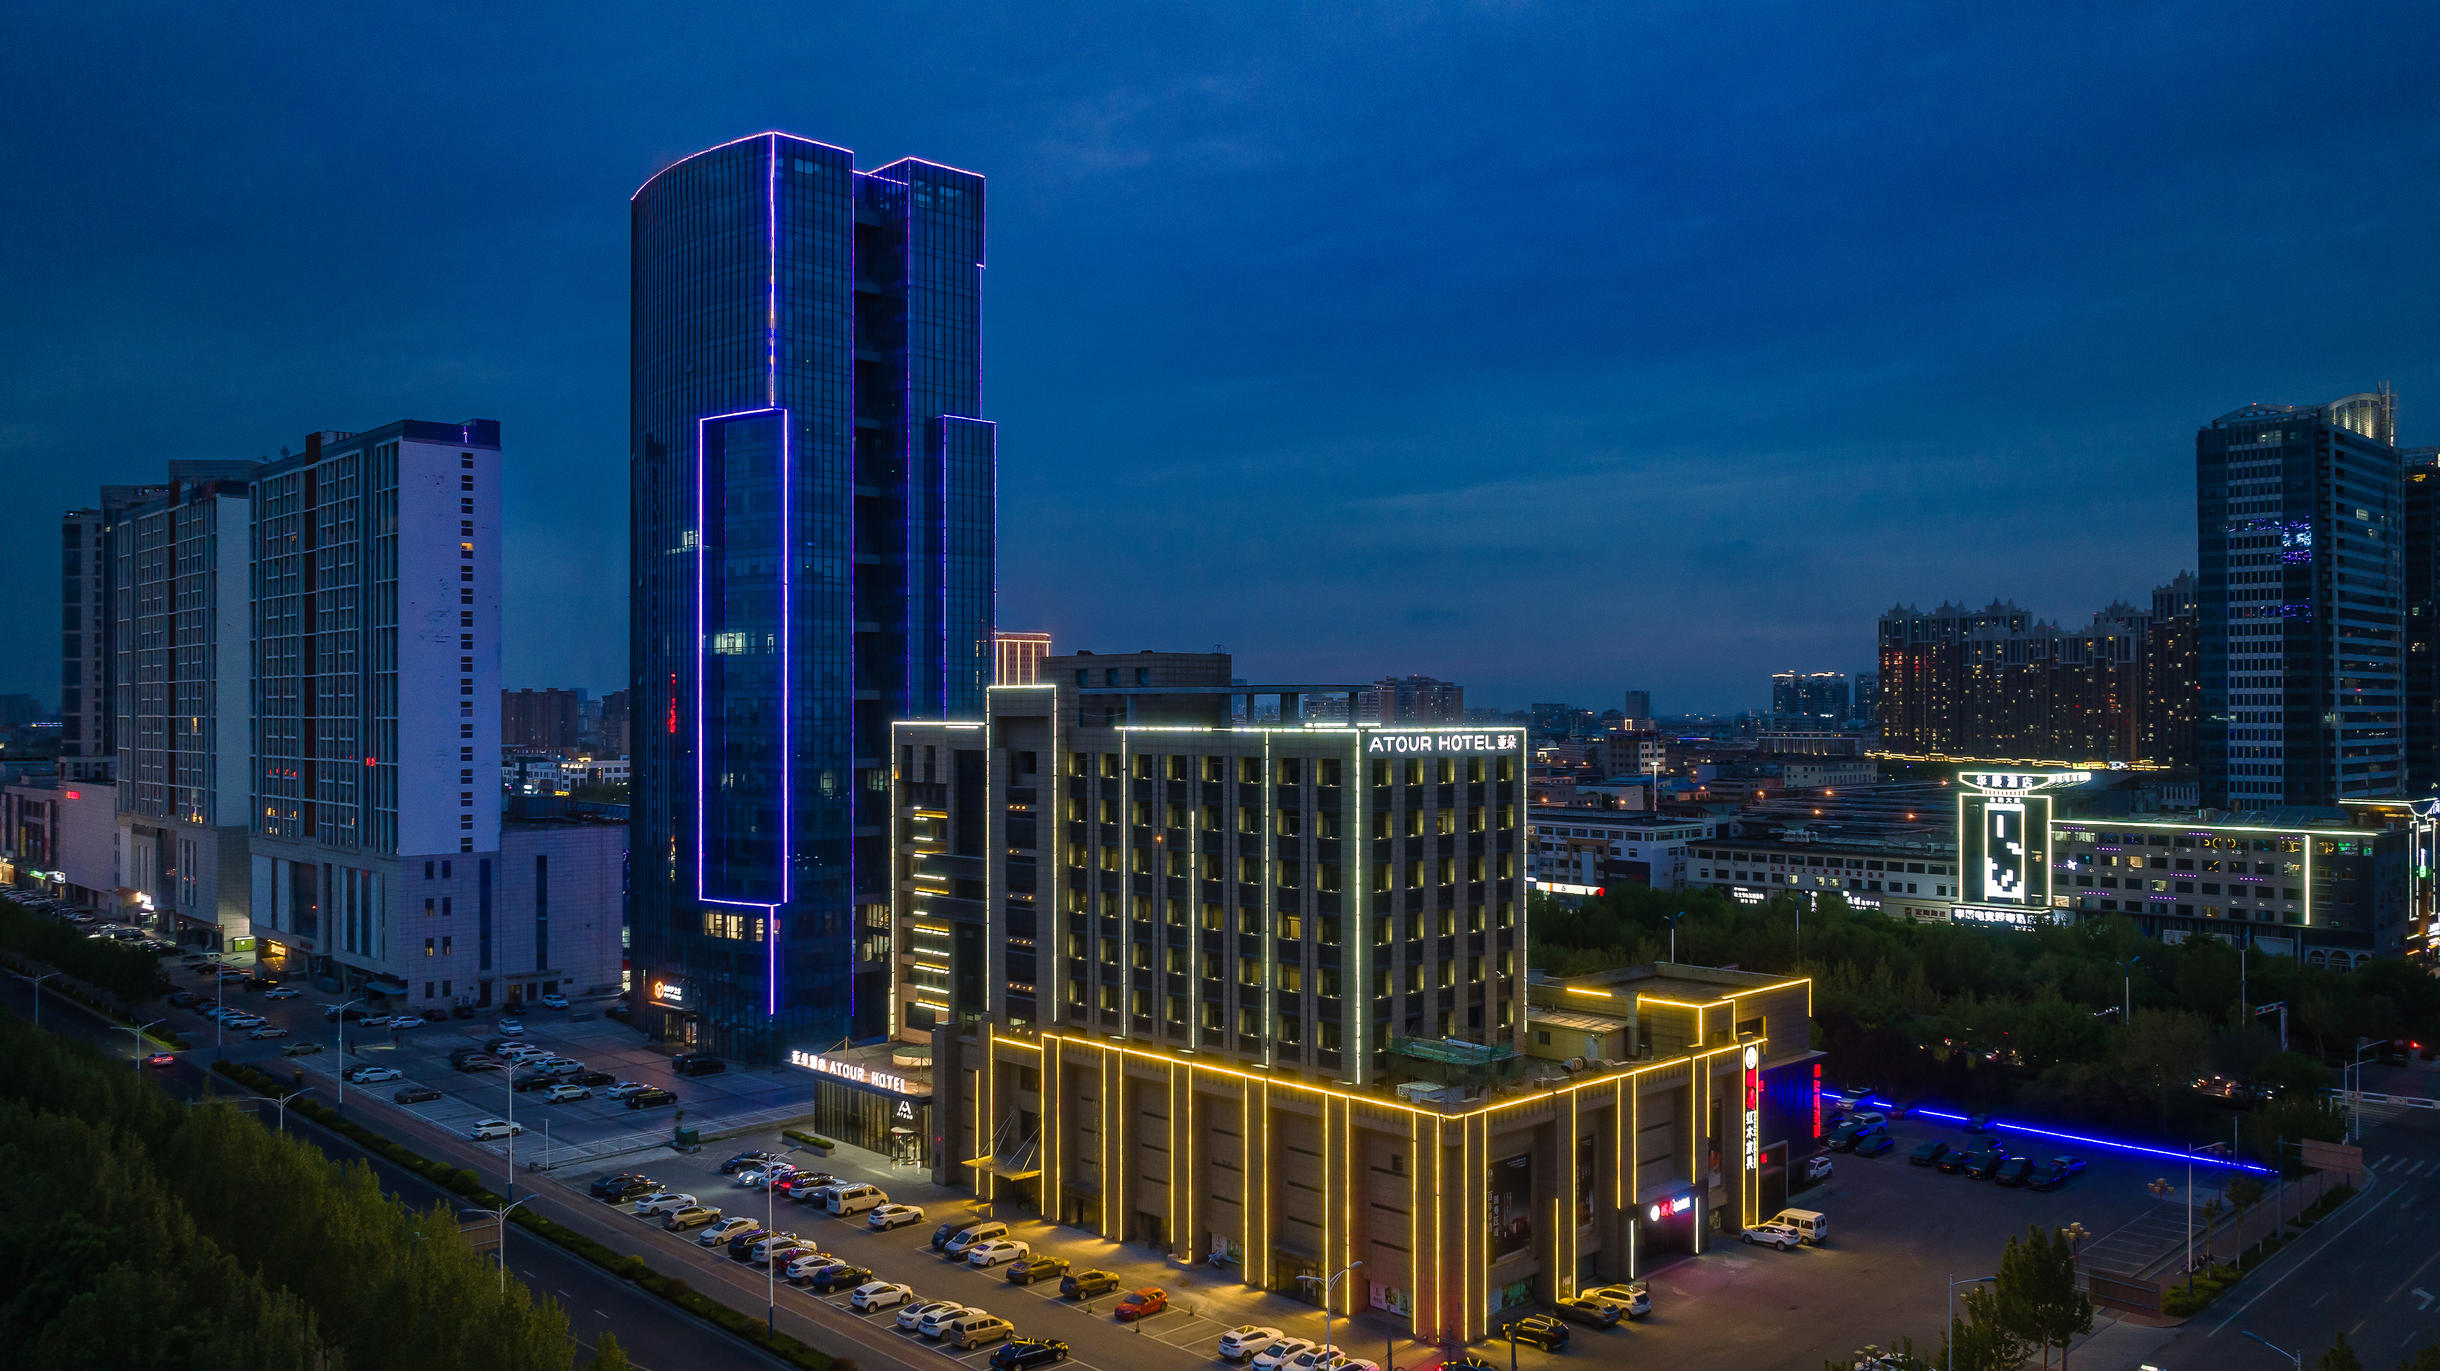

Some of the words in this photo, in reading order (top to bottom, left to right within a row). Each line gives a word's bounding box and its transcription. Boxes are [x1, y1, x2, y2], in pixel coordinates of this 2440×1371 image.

[1369, 736, 1432, 753] ATOUR
[1438, 735, 1496, 752] HOTEL
[1497, 734, 1517, 750] 亚朵
[829, 1061, 865, 1082] ATOUR
[871, 1071, 907, 1093] HOTEL
